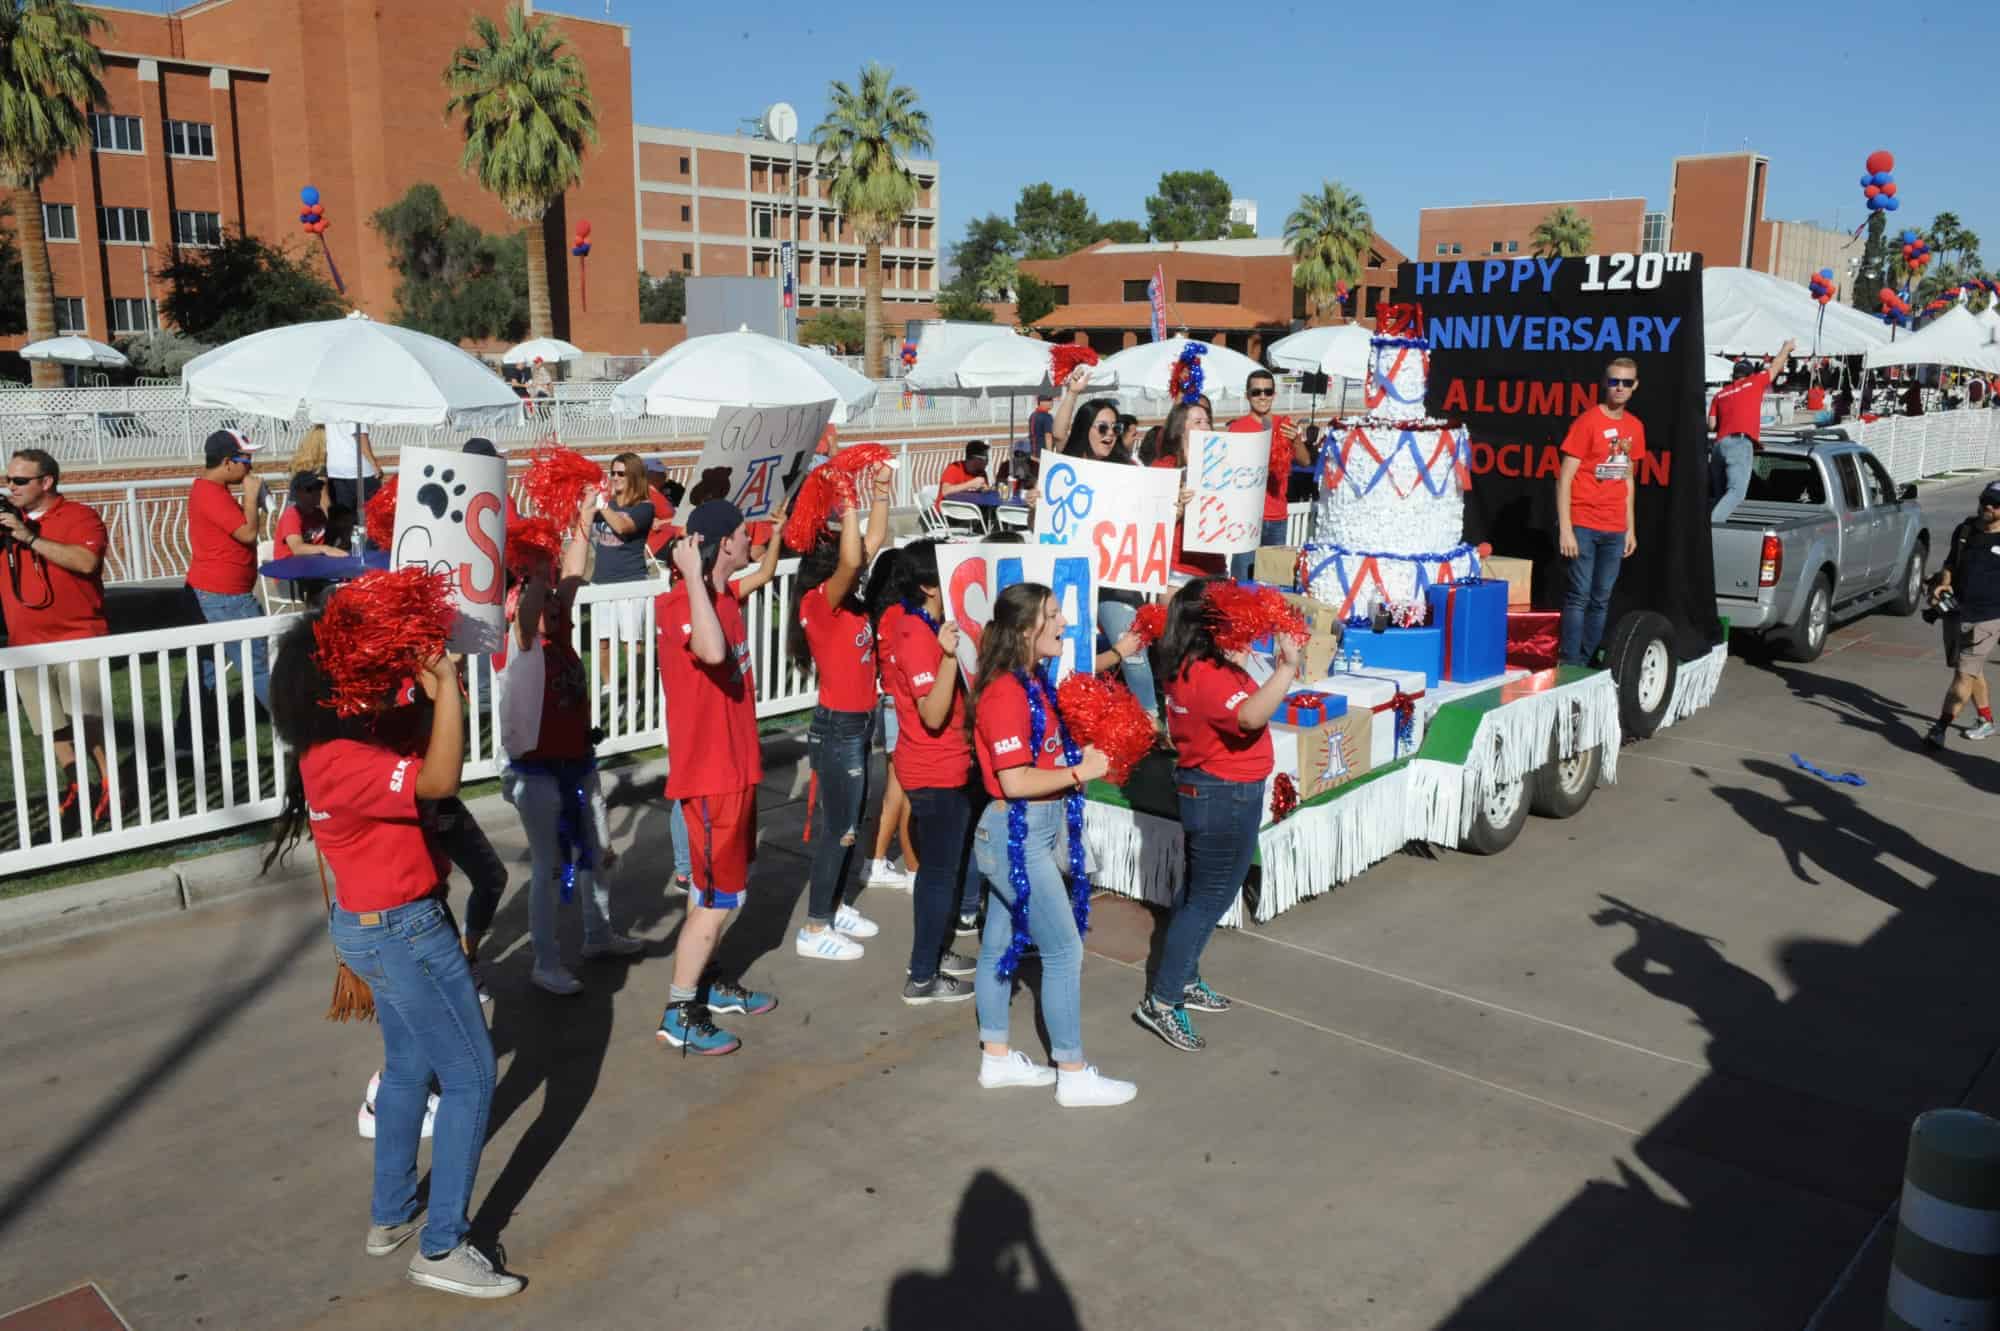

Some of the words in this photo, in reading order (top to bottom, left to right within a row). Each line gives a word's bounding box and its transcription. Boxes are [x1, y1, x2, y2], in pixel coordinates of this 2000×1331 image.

[1416, 256, 1563, 295] HAPPY
[1409, 314, 1681, 353] NNIVERSARY
[1045, 462, 1094, 534] Go
[1092, 520, 1168, 586] SAA
